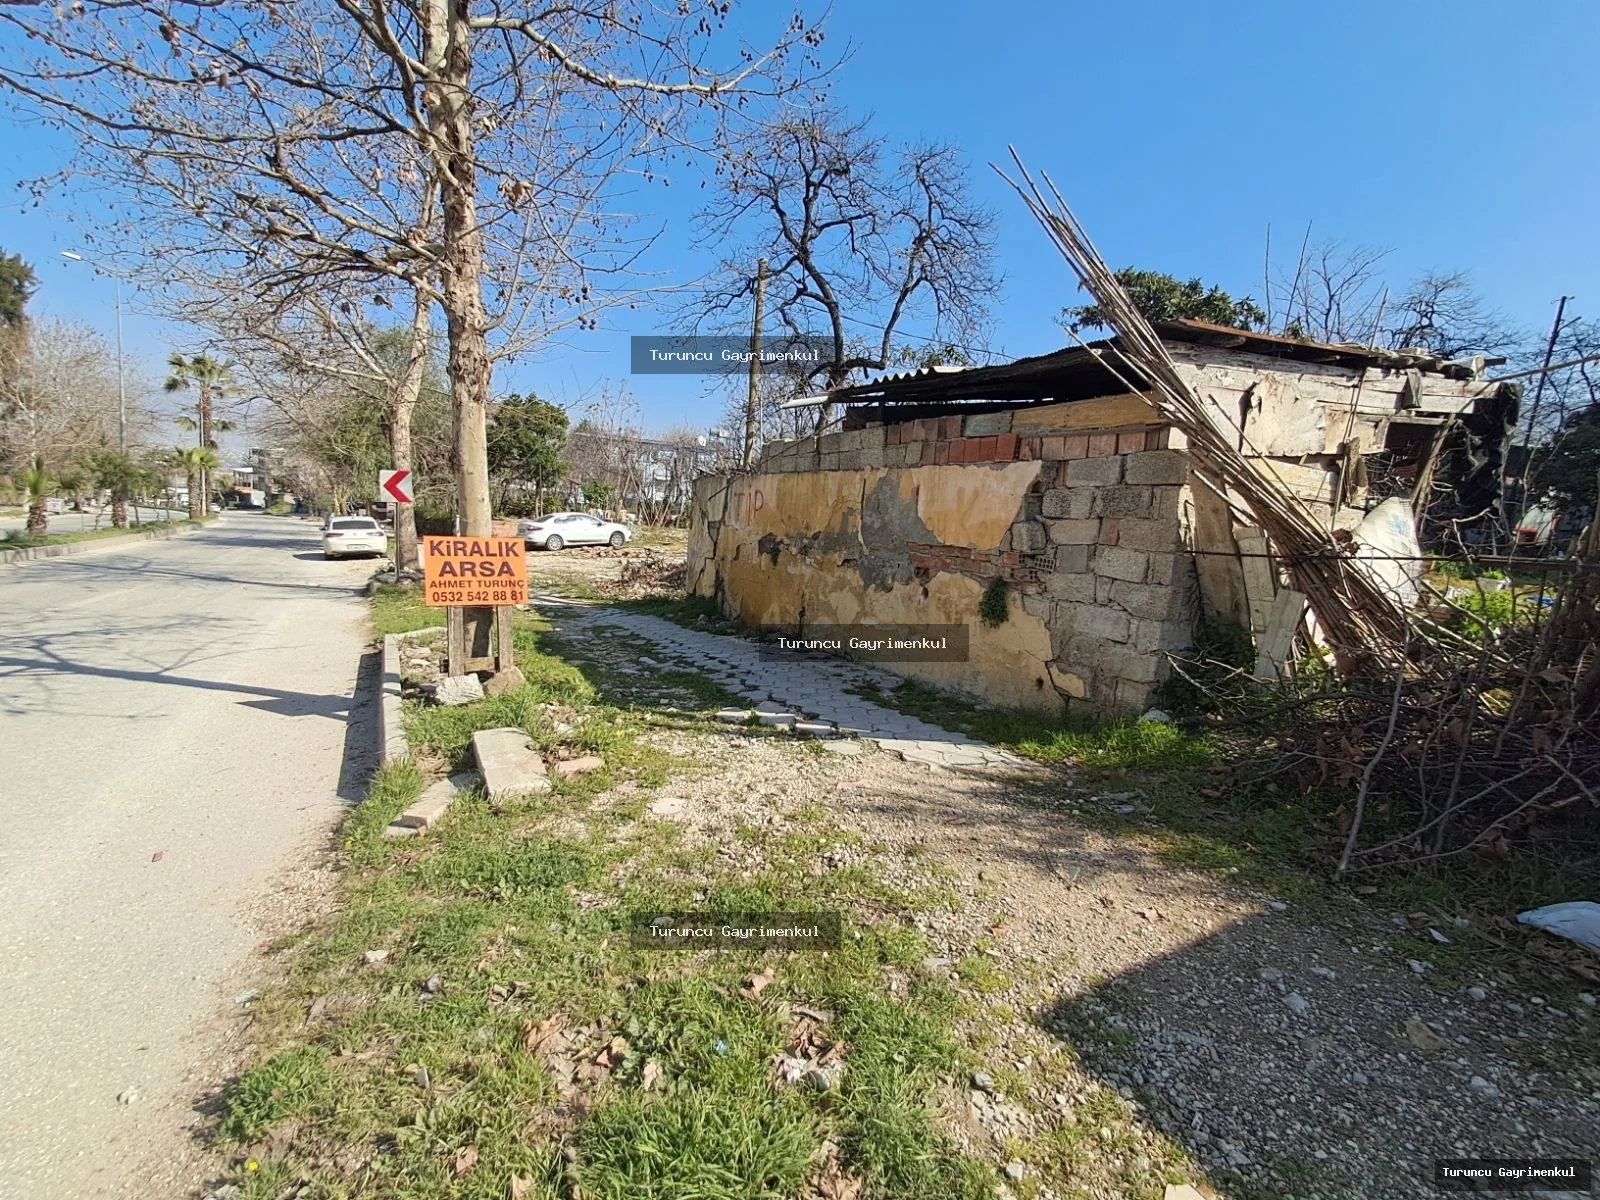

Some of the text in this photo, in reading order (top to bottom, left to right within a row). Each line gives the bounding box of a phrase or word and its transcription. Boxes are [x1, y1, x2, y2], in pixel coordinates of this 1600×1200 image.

[438, 560, 515, 578] ARSA
[429, 580, 472, 588] AHMET
[432, 590, 523, 602] 0532 542 88 81
